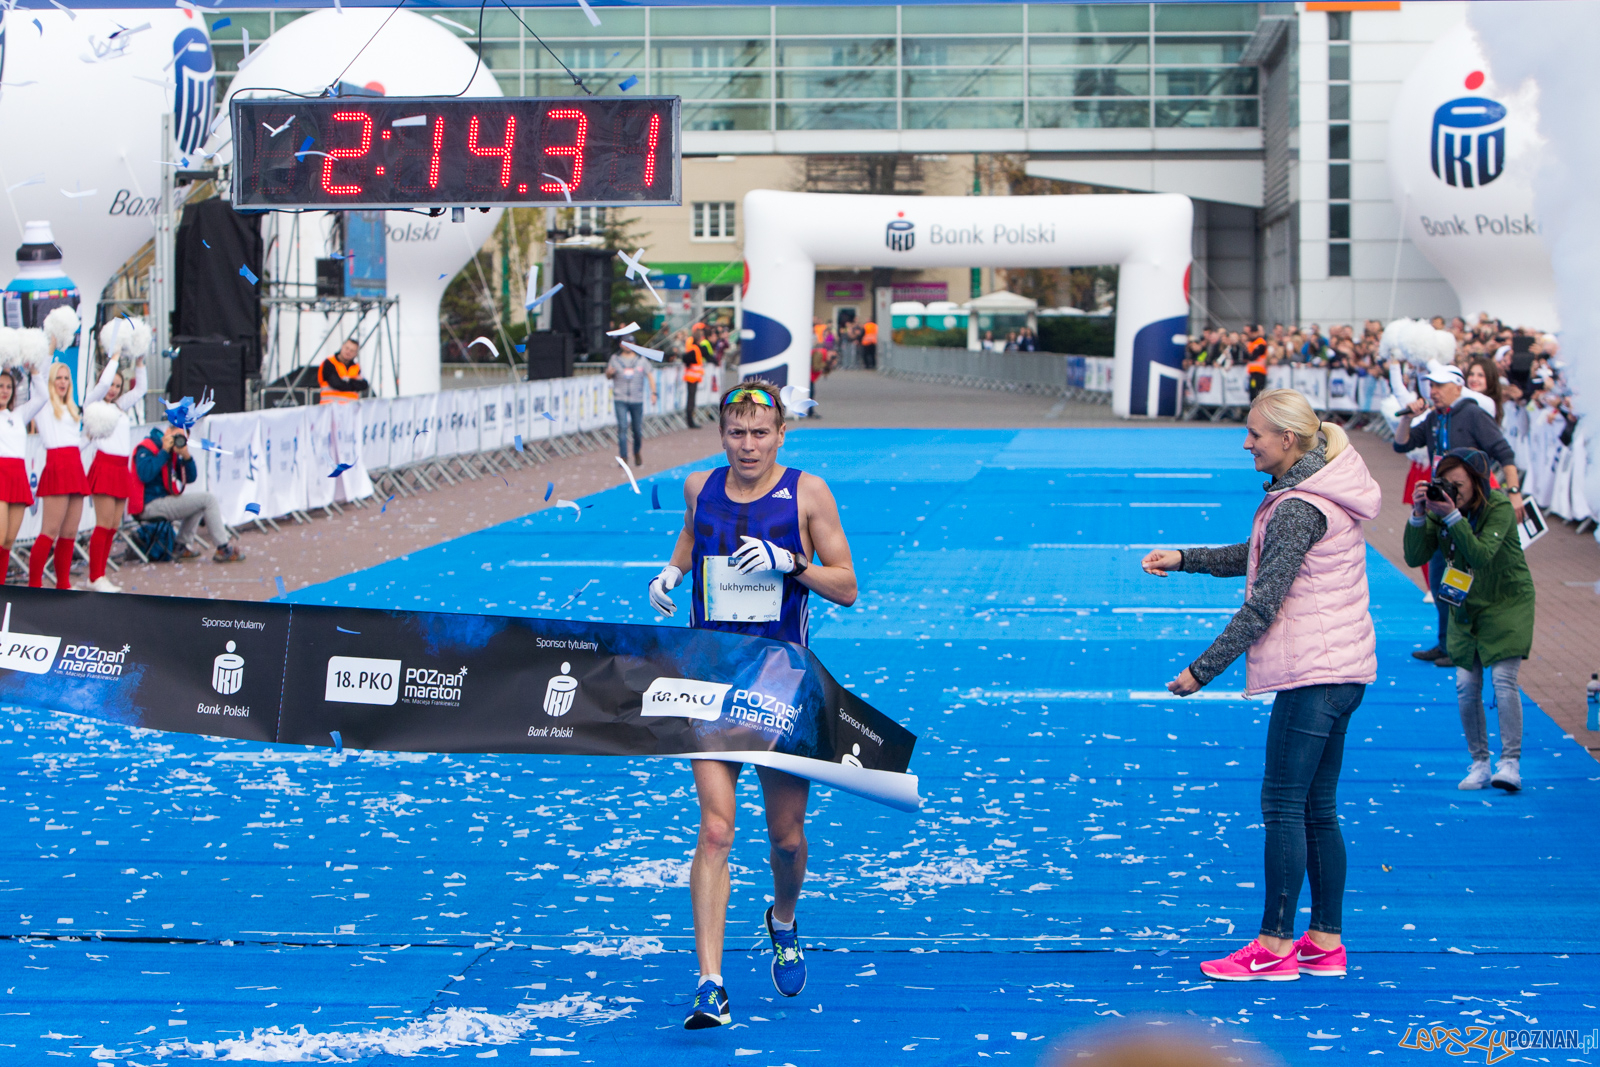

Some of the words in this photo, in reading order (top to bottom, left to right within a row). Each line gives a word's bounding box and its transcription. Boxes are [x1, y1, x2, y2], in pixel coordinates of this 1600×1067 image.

[929, 223, 984, 245] Bank
[993, 222, 1056, 245] Polski
[1420, 213, 1470, 237] Bank
[201, 616, 233, 628] Sponsor
[8, 643, 49, 662] PKO
[536, 637, 567, 648] Sponsor
[567, 639, 599, 652] tytularny
[58, 659, 123, 676] maraton
[334, 670, 355, 689] 18.
[358, 671, 393, 691] PKO
[404, 684, 462, 701] maraton
[197, 703, 221, 715] Bank
[223, 705, 250, 717] Polski
[838, 707, 862, 730] Sponsor
[730, 705, 795, 736] maraton
[527, 725, 549, 737] Bank
[549, 726, 574, 738] Polski
